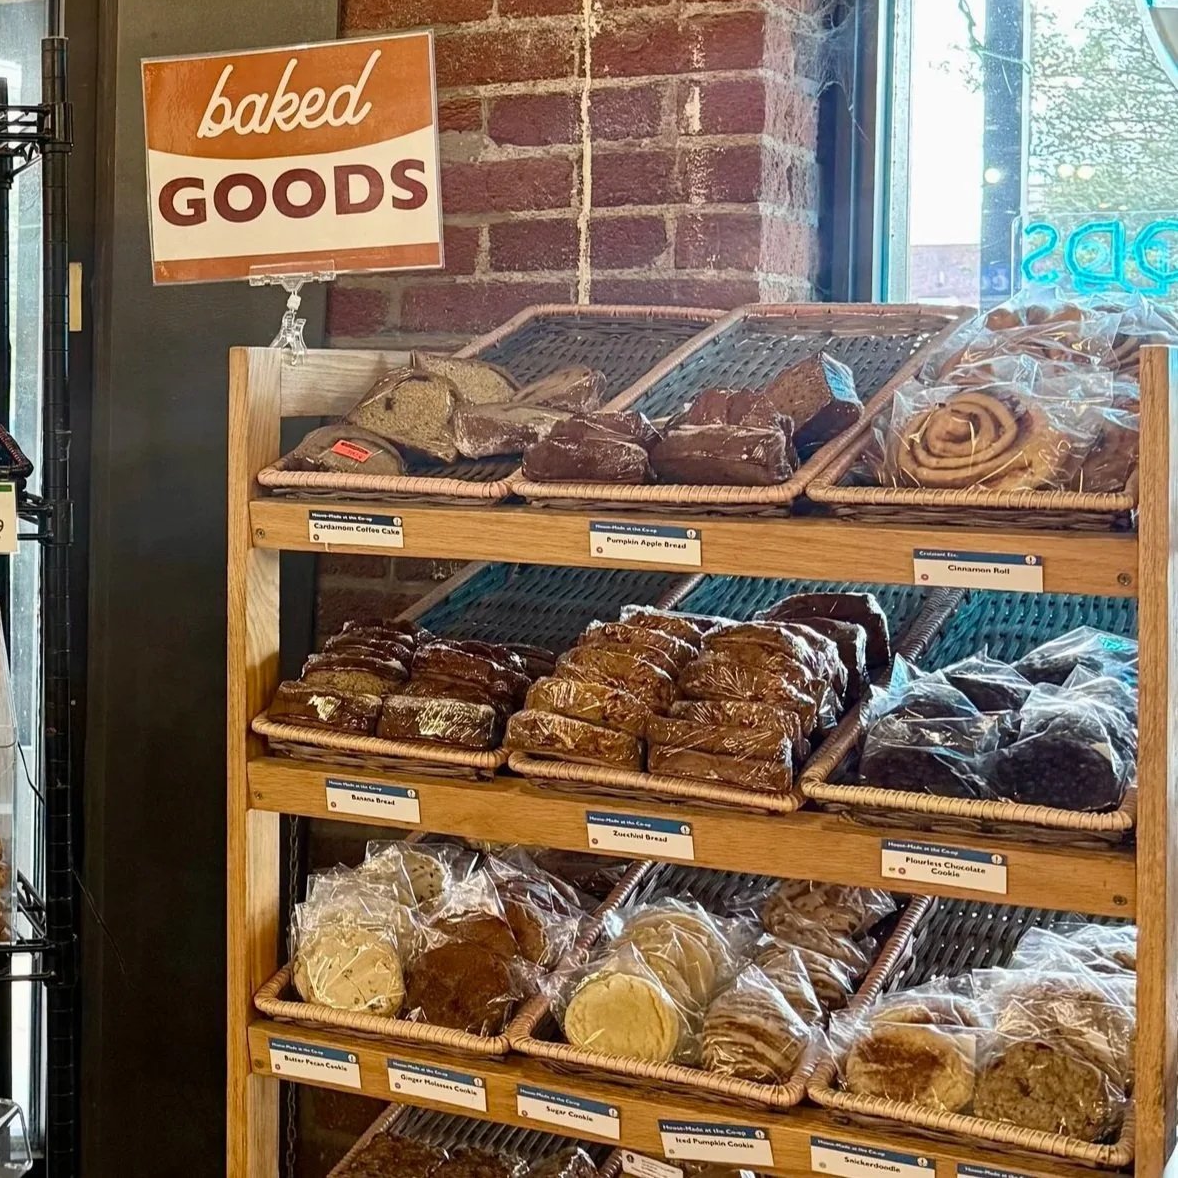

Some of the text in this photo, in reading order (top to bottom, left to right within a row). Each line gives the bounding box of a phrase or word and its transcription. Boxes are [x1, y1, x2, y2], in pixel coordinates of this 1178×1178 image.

[197, 49, 382, 139] baked
[158, 159, 428, 227] GOODS
[313, 523, 354, 531] Cardamom
[356, 525, 380, 534] Coffee
[606, 536, 687, 549] Pumpkin Apple Bread
[947, 564, 1010, 575] Cinnamon Roll
[351, 794, 396, 806] Banana Bread
[612, 829, 668, 843] Zucchini Bread
[905, 856, 986, 874] Flourless Chocolate
[930, 867, 960, 878] Cookie
[284, 1054, 348, 1072] Butter Pecan Cookie
[400, 1073, 478, 1096] Ginger Molasses Cookie
[546, 1105, 593, 1122] Sugar Cookie
[713, 1127, 724, 1135] the
[693, 1138, 726, 1147] Pumpkin
[727, 1141, 755, 1149] Cookie
[843, 1156, 901, 1173] Snickerdoodle
